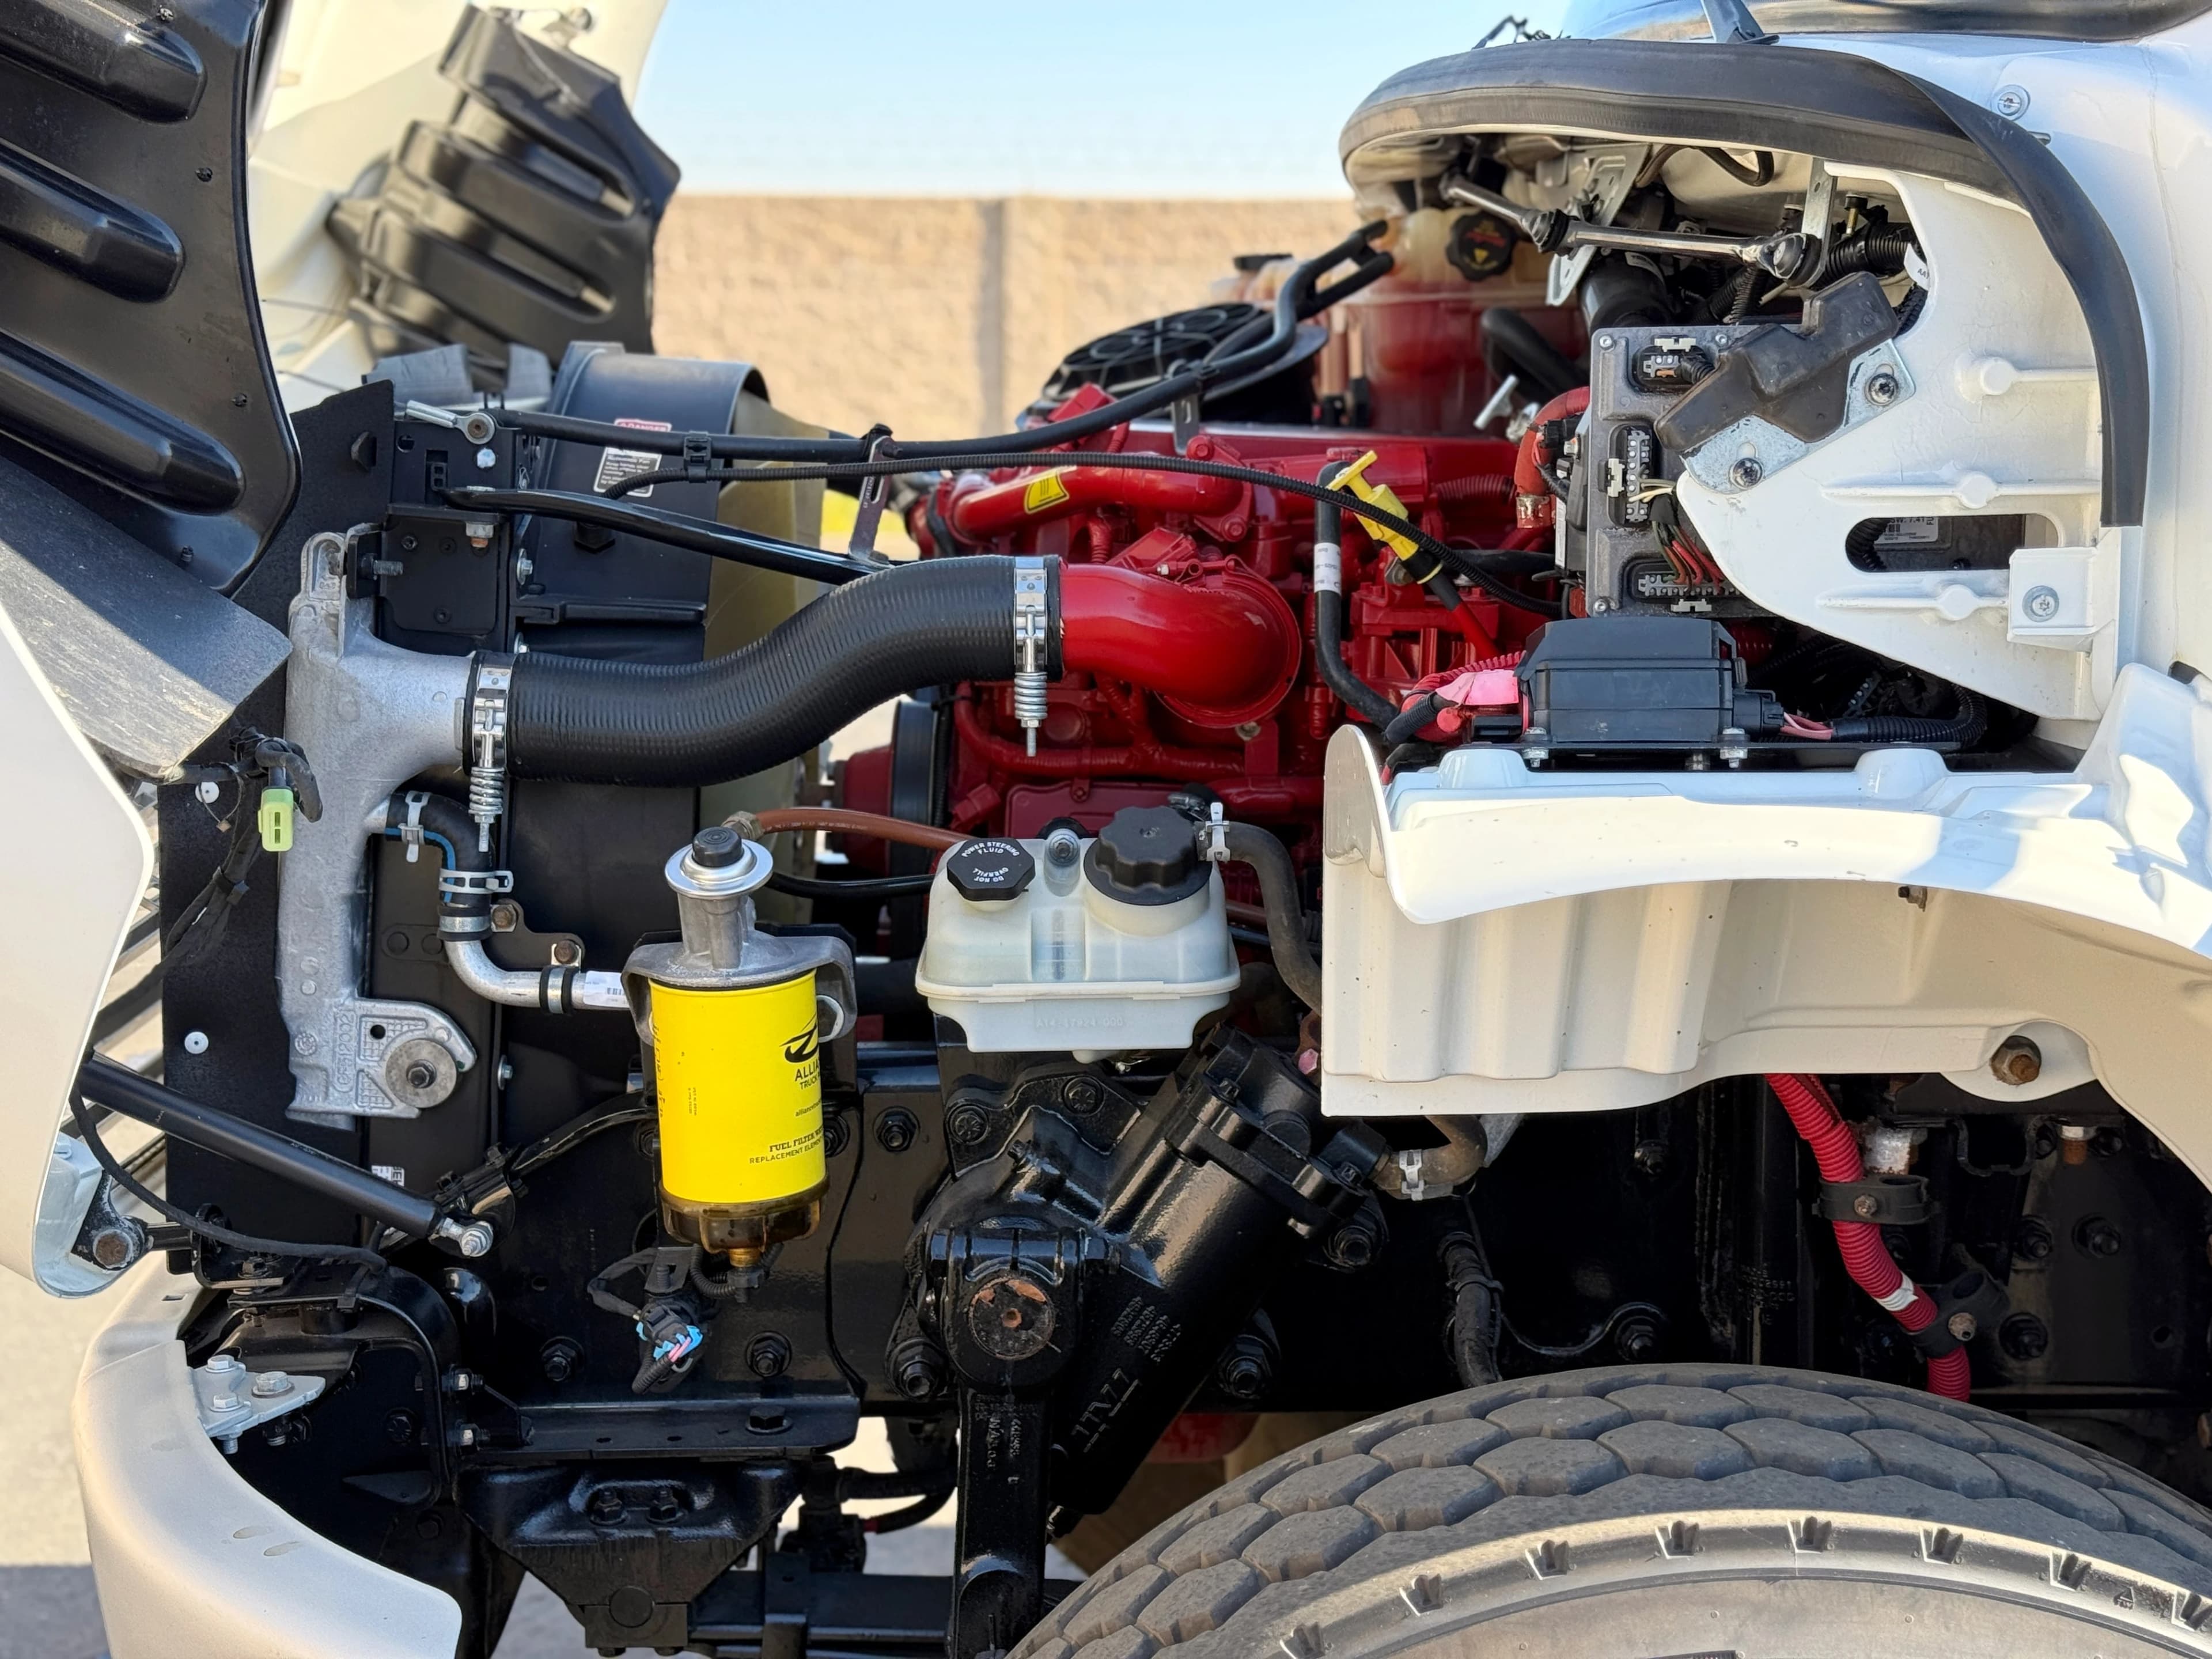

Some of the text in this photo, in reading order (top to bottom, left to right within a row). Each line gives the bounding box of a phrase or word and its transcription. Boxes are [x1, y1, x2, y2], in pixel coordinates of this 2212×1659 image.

[961, 842, 1020, 857] POWER STEERING
[972, 867, 1009, 877] OVERFILL
[795, 1058, 819, 1082] ALLIA
[770, 1142, 792, 1152] FUEL
[793, 1132, 814, 1147] FILTER
[749, 1147, 803, 1164] REPLACEMENT
